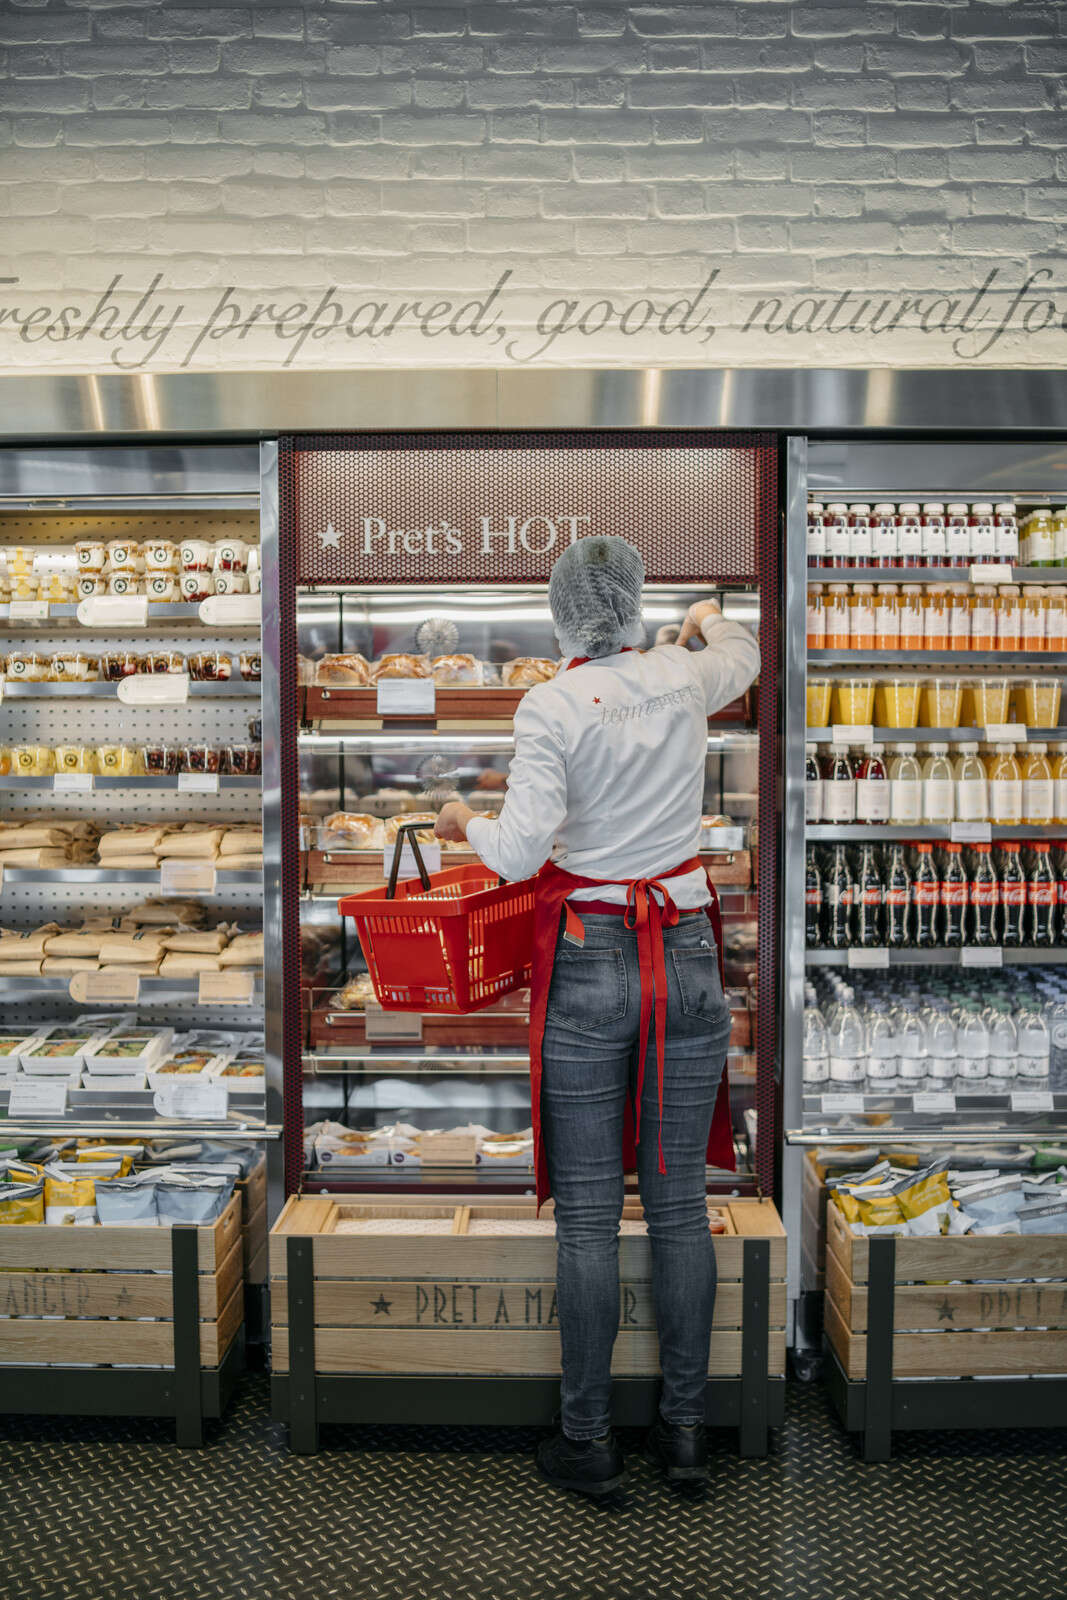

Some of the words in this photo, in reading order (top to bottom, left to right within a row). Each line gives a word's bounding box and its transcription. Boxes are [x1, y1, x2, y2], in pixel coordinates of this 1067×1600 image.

[0, 273, 183, 369] reshly
[180, 269, 514, 368] prepared,
[505, 268, 720, 361] good,
[740, 268, 999, 334] natural
[953, 268, 1067, 358] fo
[360, 516, 463, 554] Pret's
[477, 515, 591, 553] HOT
[416, 1284, 480, 1324] PRET
[495, 1287, 510, 1324] A
[525, 1286, 637, 1325] MAR
